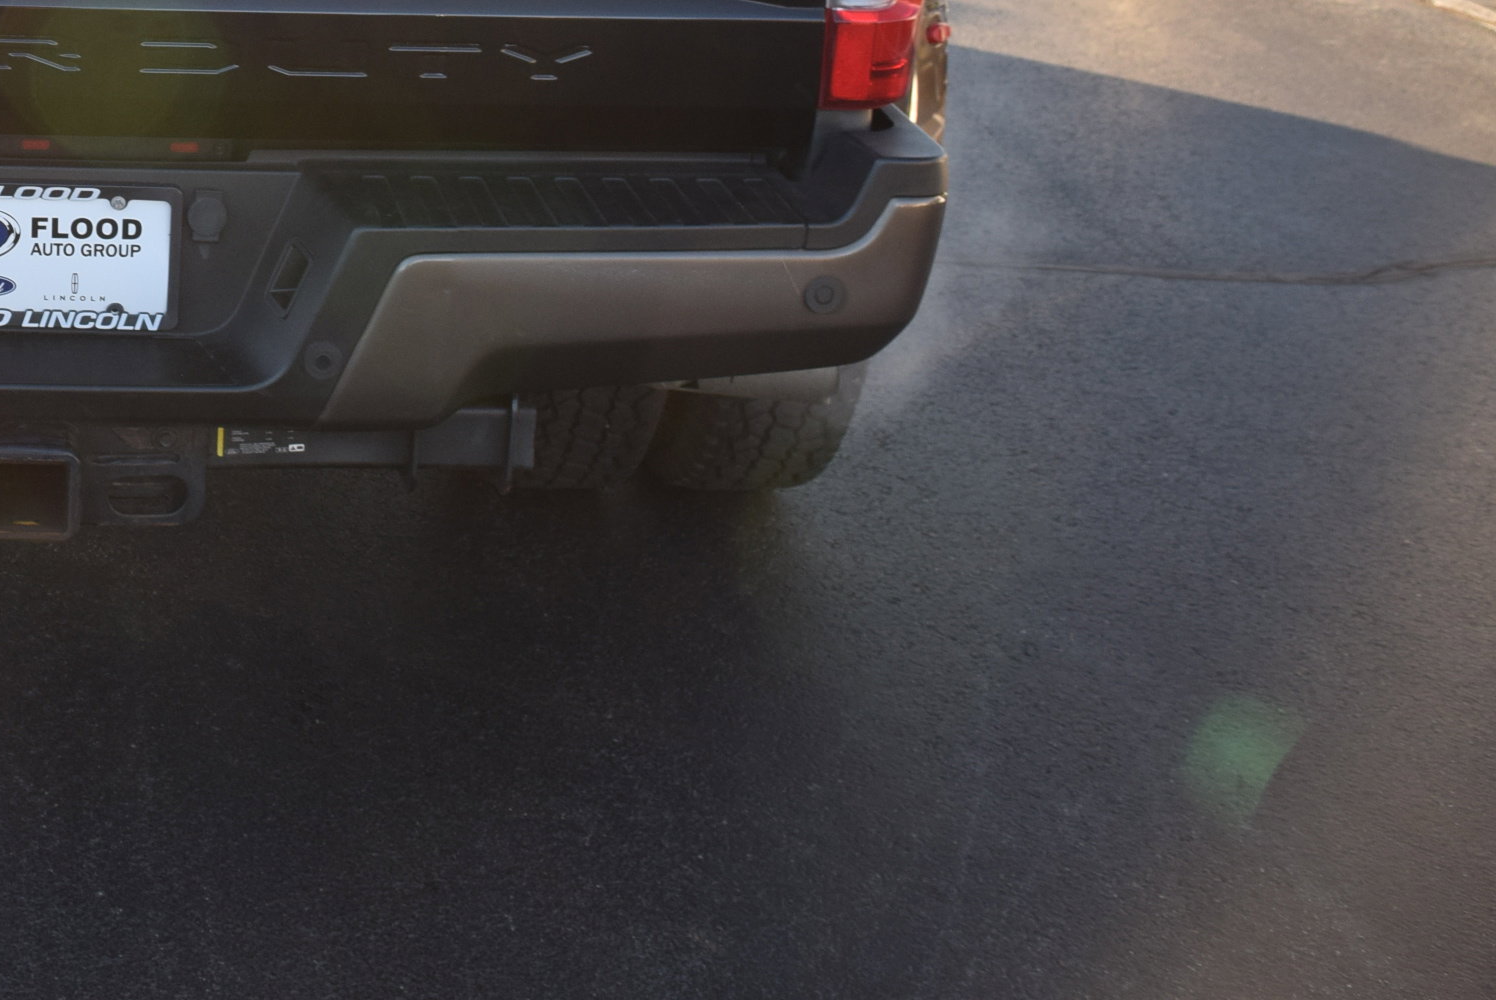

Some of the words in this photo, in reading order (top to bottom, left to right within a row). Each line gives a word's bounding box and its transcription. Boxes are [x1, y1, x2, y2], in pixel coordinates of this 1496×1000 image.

[30, 217, 142, 240] FLOOD
[30, 243, 75, 257] AUTO
[80, 244, 142, 258] GROUP
[21, 310, 164, 331] LINCOLN
